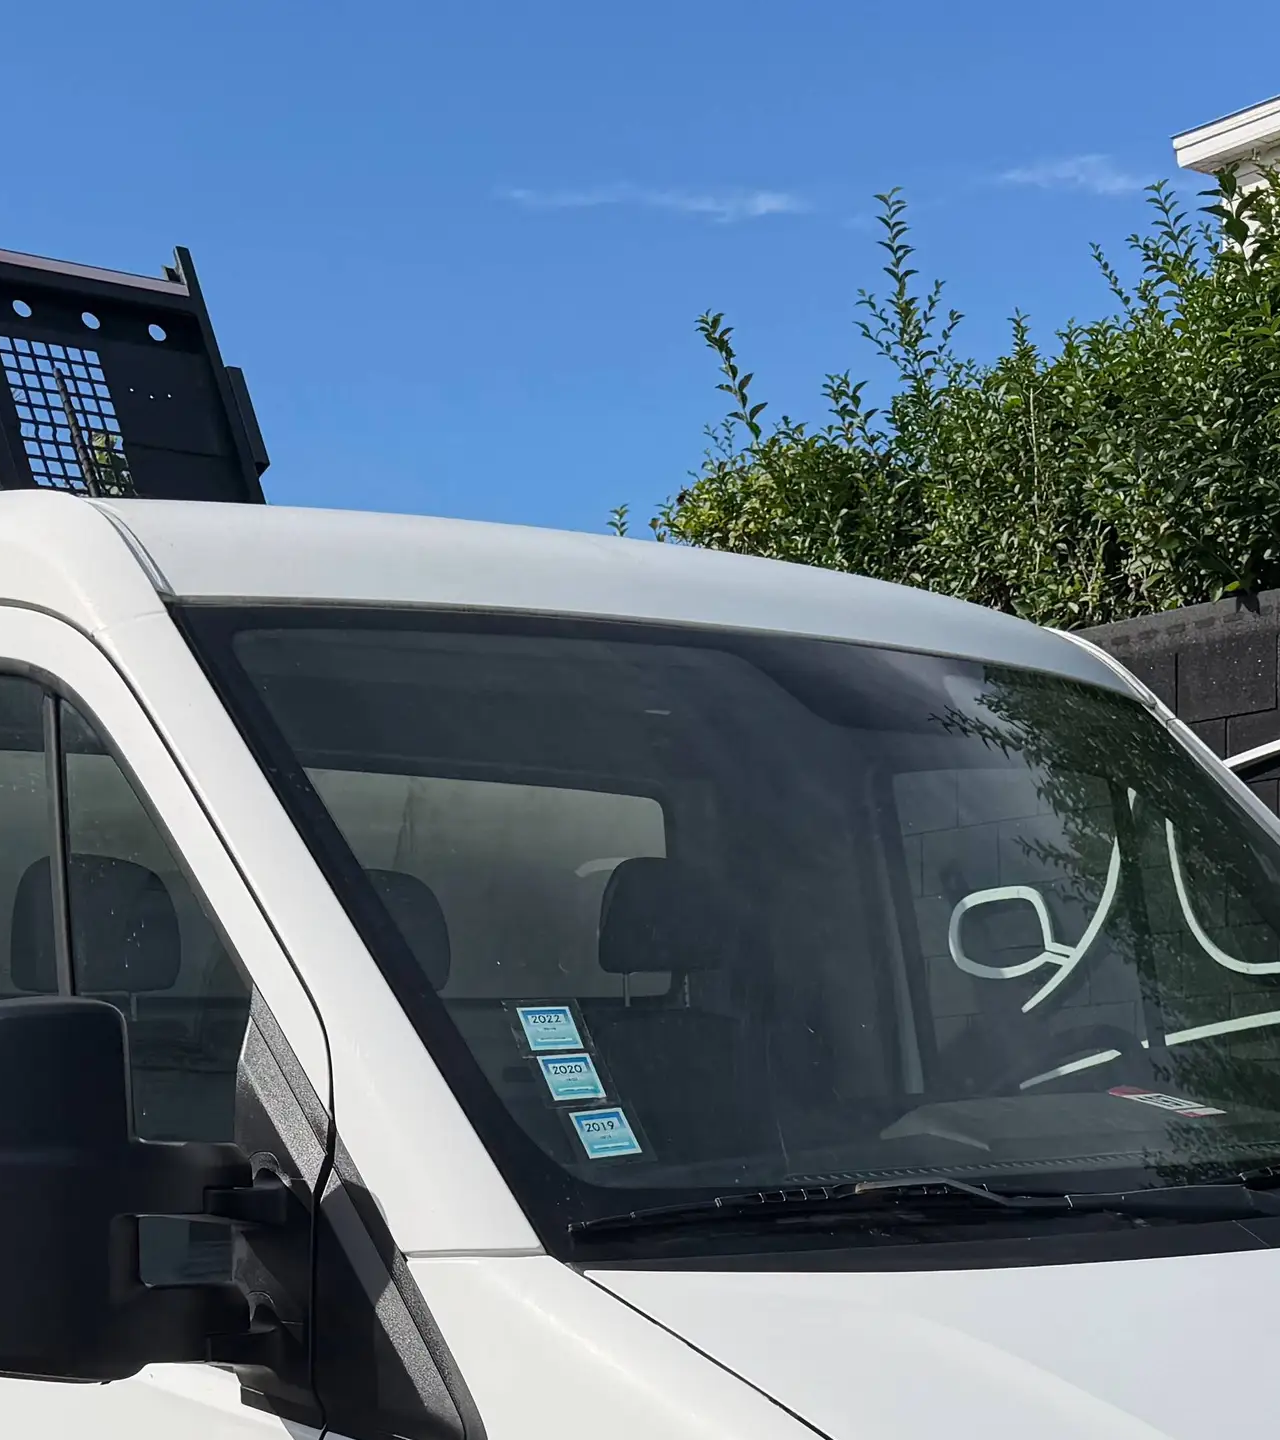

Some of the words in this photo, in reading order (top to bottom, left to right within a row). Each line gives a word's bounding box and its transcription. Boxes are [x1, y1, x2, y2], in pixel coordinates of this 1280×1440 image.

[531, 1014, 562, 1024] 2022
[552, 1064, 583, 1075] 2020
[584, 1120, 615, 1132] 2019
